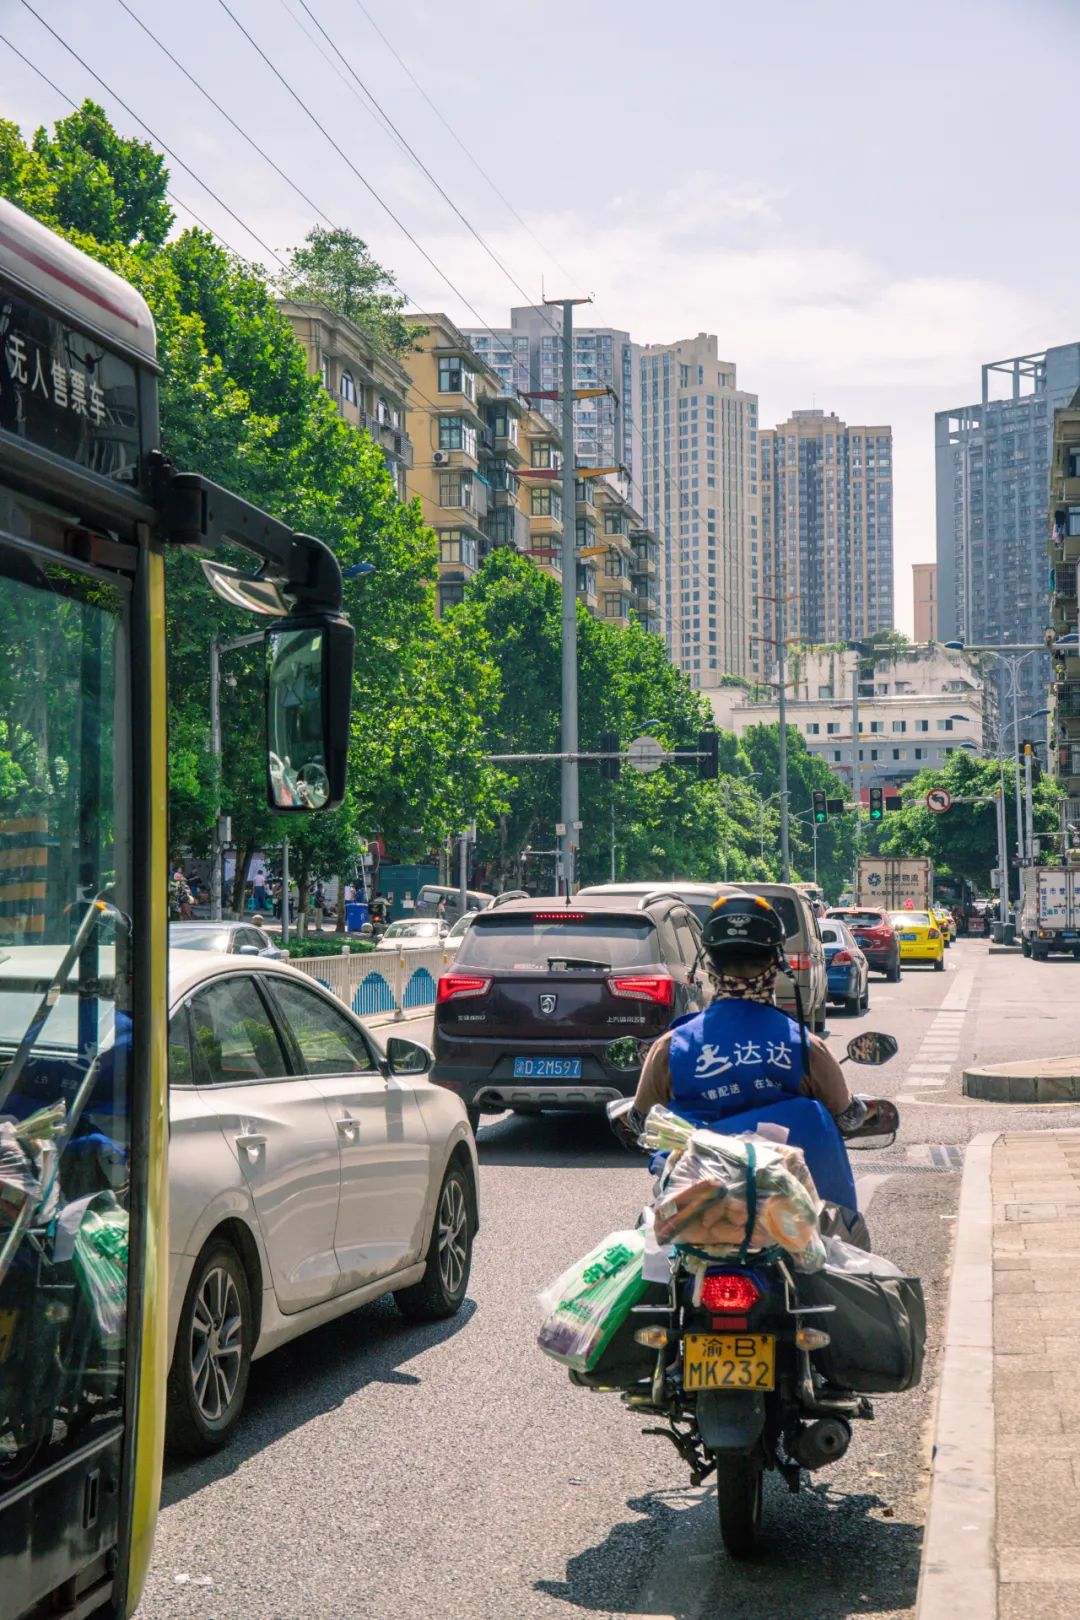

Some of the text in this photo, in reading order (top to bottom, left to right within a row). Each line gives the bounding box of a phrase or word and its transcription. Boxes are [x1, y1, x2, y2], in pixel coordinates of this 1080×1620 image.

[9, 335, 106, 426] 无人售票车
[733, 1040, 793, 1070] 达达
[688, 1360, 769, 1387] MK232
